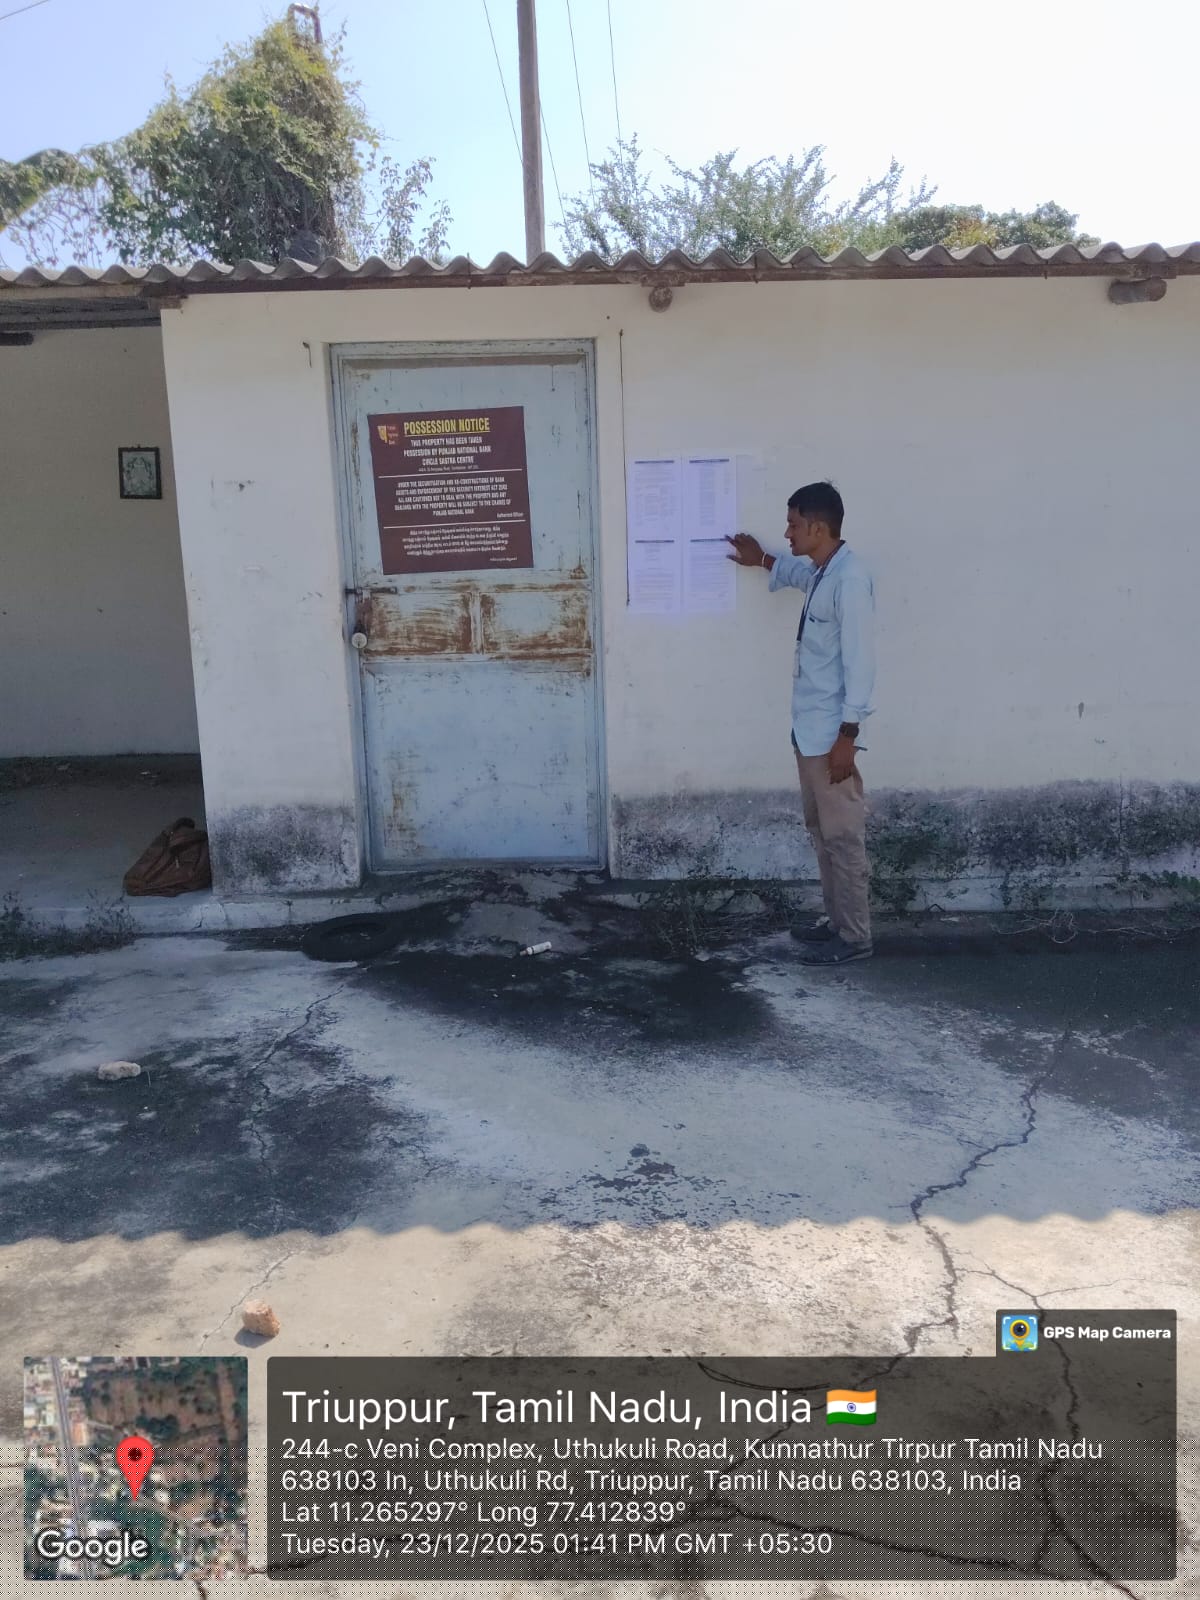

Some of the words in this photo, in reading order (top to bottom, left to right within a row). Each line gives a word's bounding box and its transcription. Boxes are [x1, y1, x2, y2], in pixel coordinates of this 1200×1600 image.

[403, 419, 457, 435] POSSESSION
[458, 417, 490, 432] NOTICE
[411, 439, 421, 447] THIS
[422, 438, 446, 447] PROPERTY
[446, 437, 455, 445] HAS
[456, 436, 468, 445] BEEN
[468, 436, 483, 444] TAKEN
[403, 449, 431, 457] POSSESSION
[432, 448, 439, 456] BY
[439, 447, 457, 455] PUNJAB
[457, 446, 478, 454] NATIONAL
[479, 445, 492, 453] BANK
[422, 458, 439, 466] CIRCLE
[457, 456, 475, 464] CENTRE
